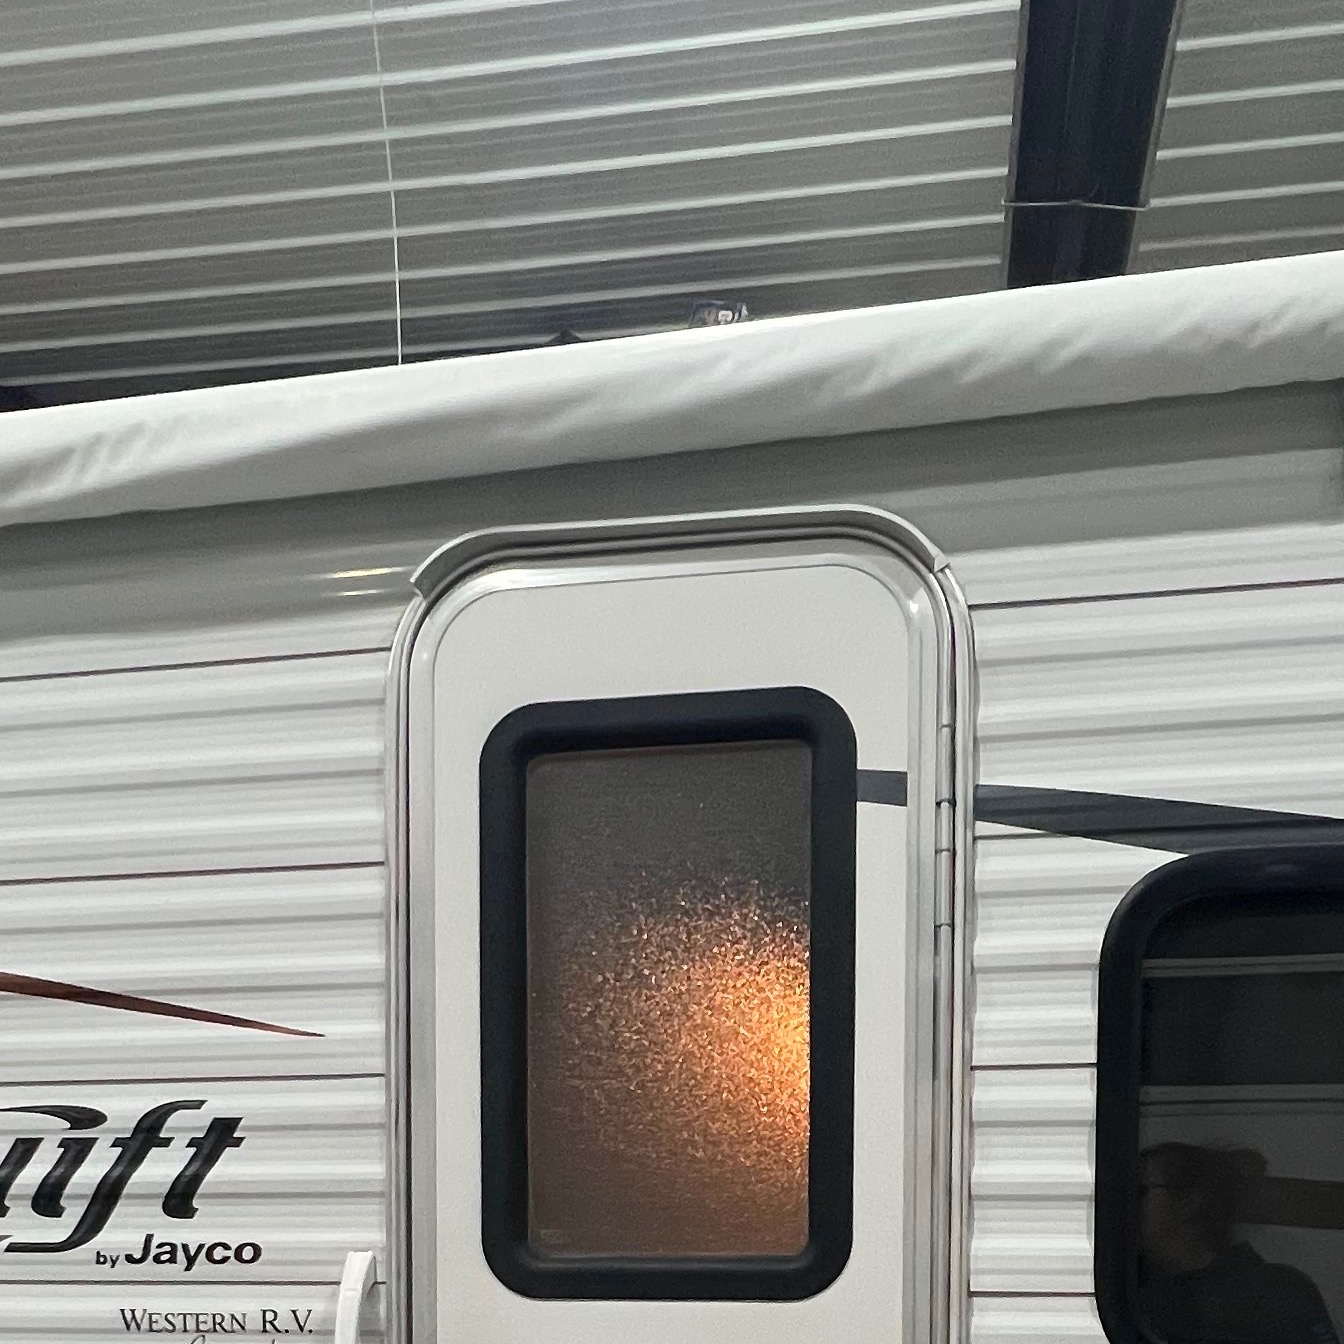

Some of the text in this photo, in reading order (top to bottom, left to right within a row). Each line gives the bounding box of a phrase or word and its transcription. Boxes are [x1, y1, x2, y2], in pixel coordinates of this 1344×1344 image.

[95, 1234, 263, 1272] by Jayco
[119, 1308, 314, 1334] WESTERN R.V.
